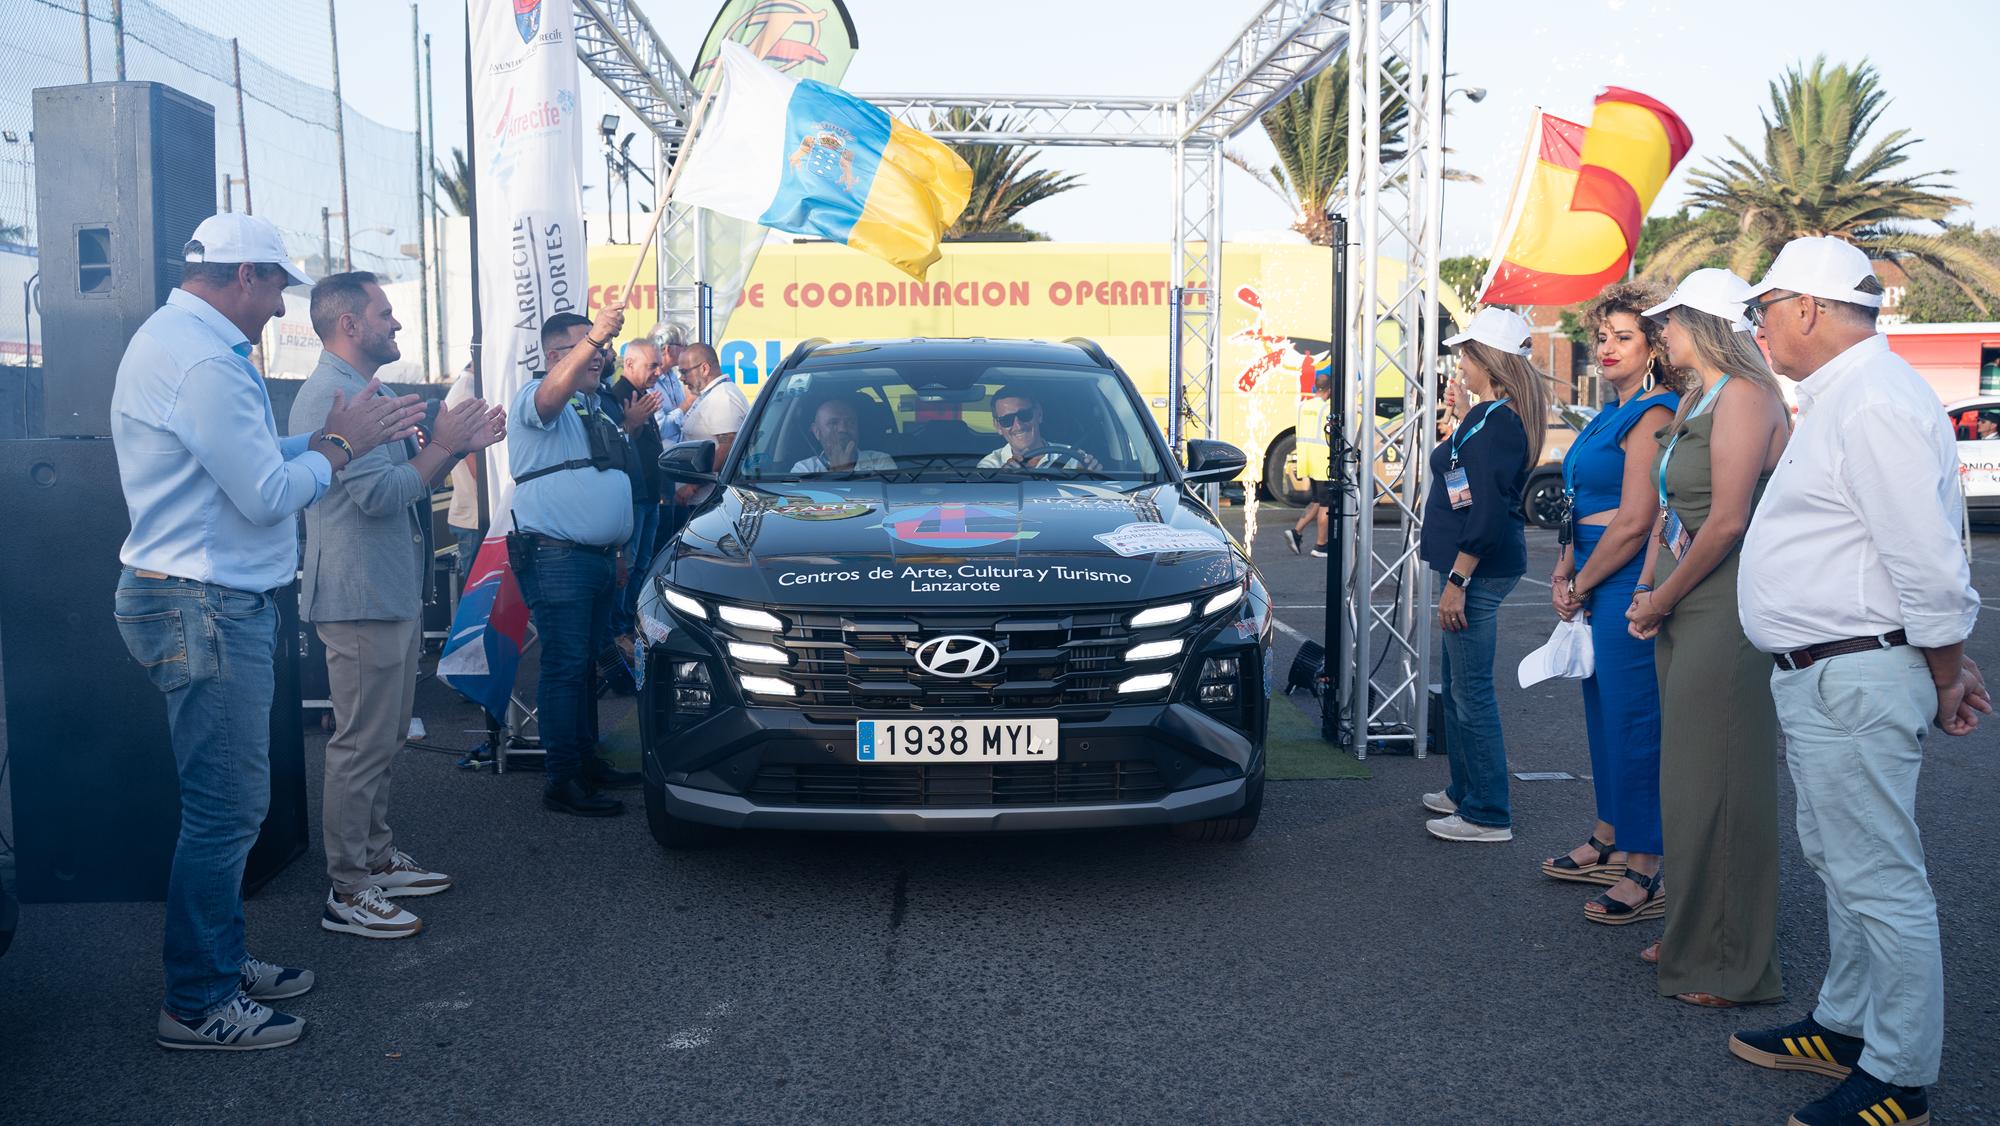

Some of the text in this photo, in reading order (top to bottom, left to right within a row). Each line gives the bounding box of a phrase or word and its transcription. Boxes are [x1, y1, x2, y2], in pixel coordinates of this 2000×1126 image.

[588, 284, 656, 309] CENT
[783, 281, 1029, 308] COORDINACION
[778, 565, 1132, 586] Centros de Arte, Cultura y Turismo
[911, 581, 1000, 592] Lanzarote
[886, 725, 968, 755] 1938
[982, 725, 1044, 755] MYL
